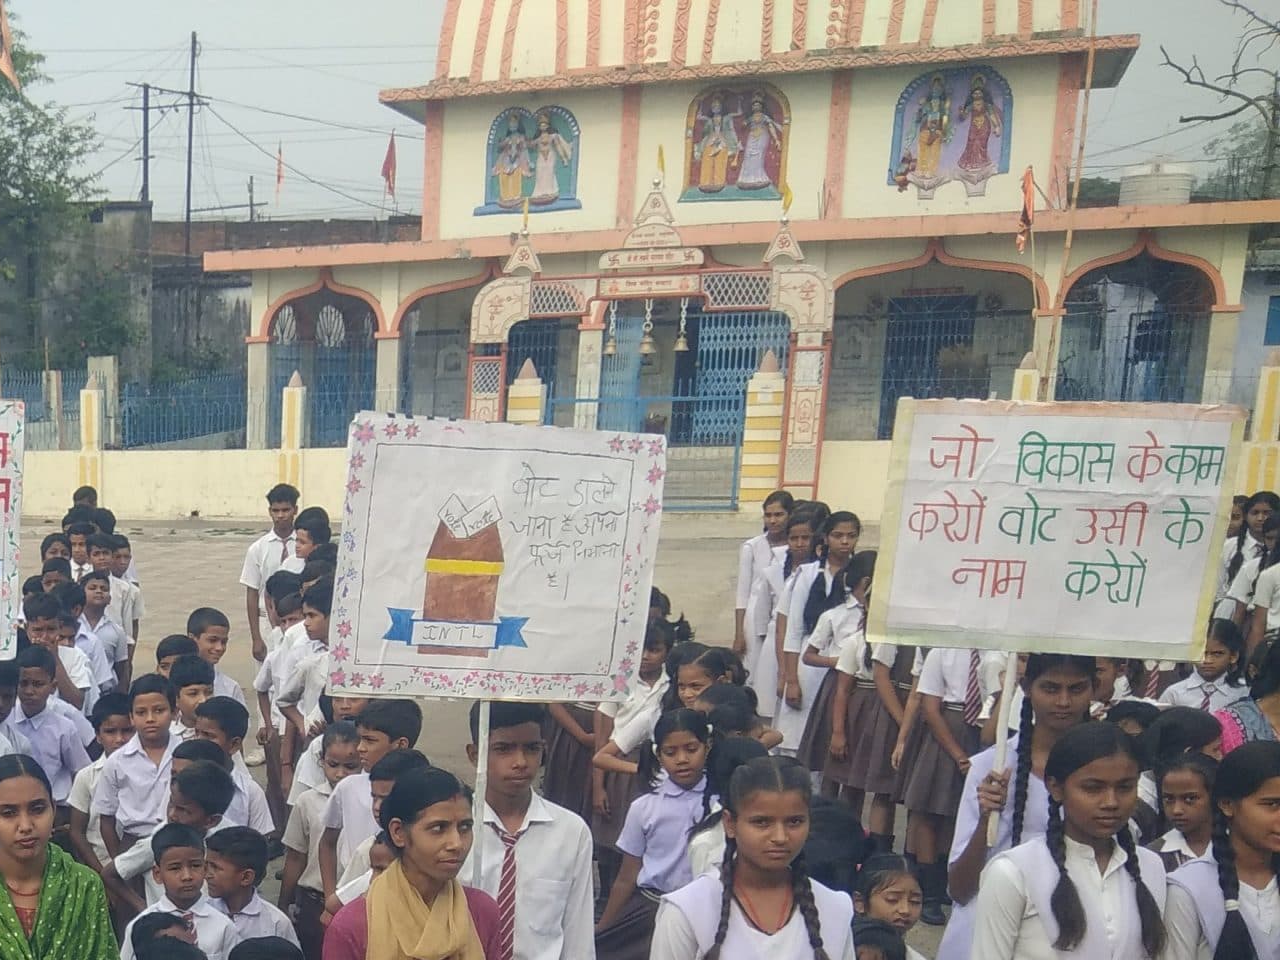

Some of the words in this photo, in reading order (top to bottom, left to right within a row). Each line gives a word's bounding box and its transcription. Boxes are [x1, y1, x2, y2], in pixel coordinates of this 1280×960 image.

[930, 424, 995, 479] जो
[1016, 430, 1116, 484] विकास
[1127, 430, 1166, 484] के
[1165, 444, 1225, 486] काम
[512, 462, 560, 507] वोट
[509, 516, 558, 539] जाना
[575, 510, 626, 536] अपना
[997, 492, 1062, 545] वोट
[1076, 501, 1149, 546] उसी
[1162, 498, 1211, 549] के
[952, 559, 1027, 599] नाम
